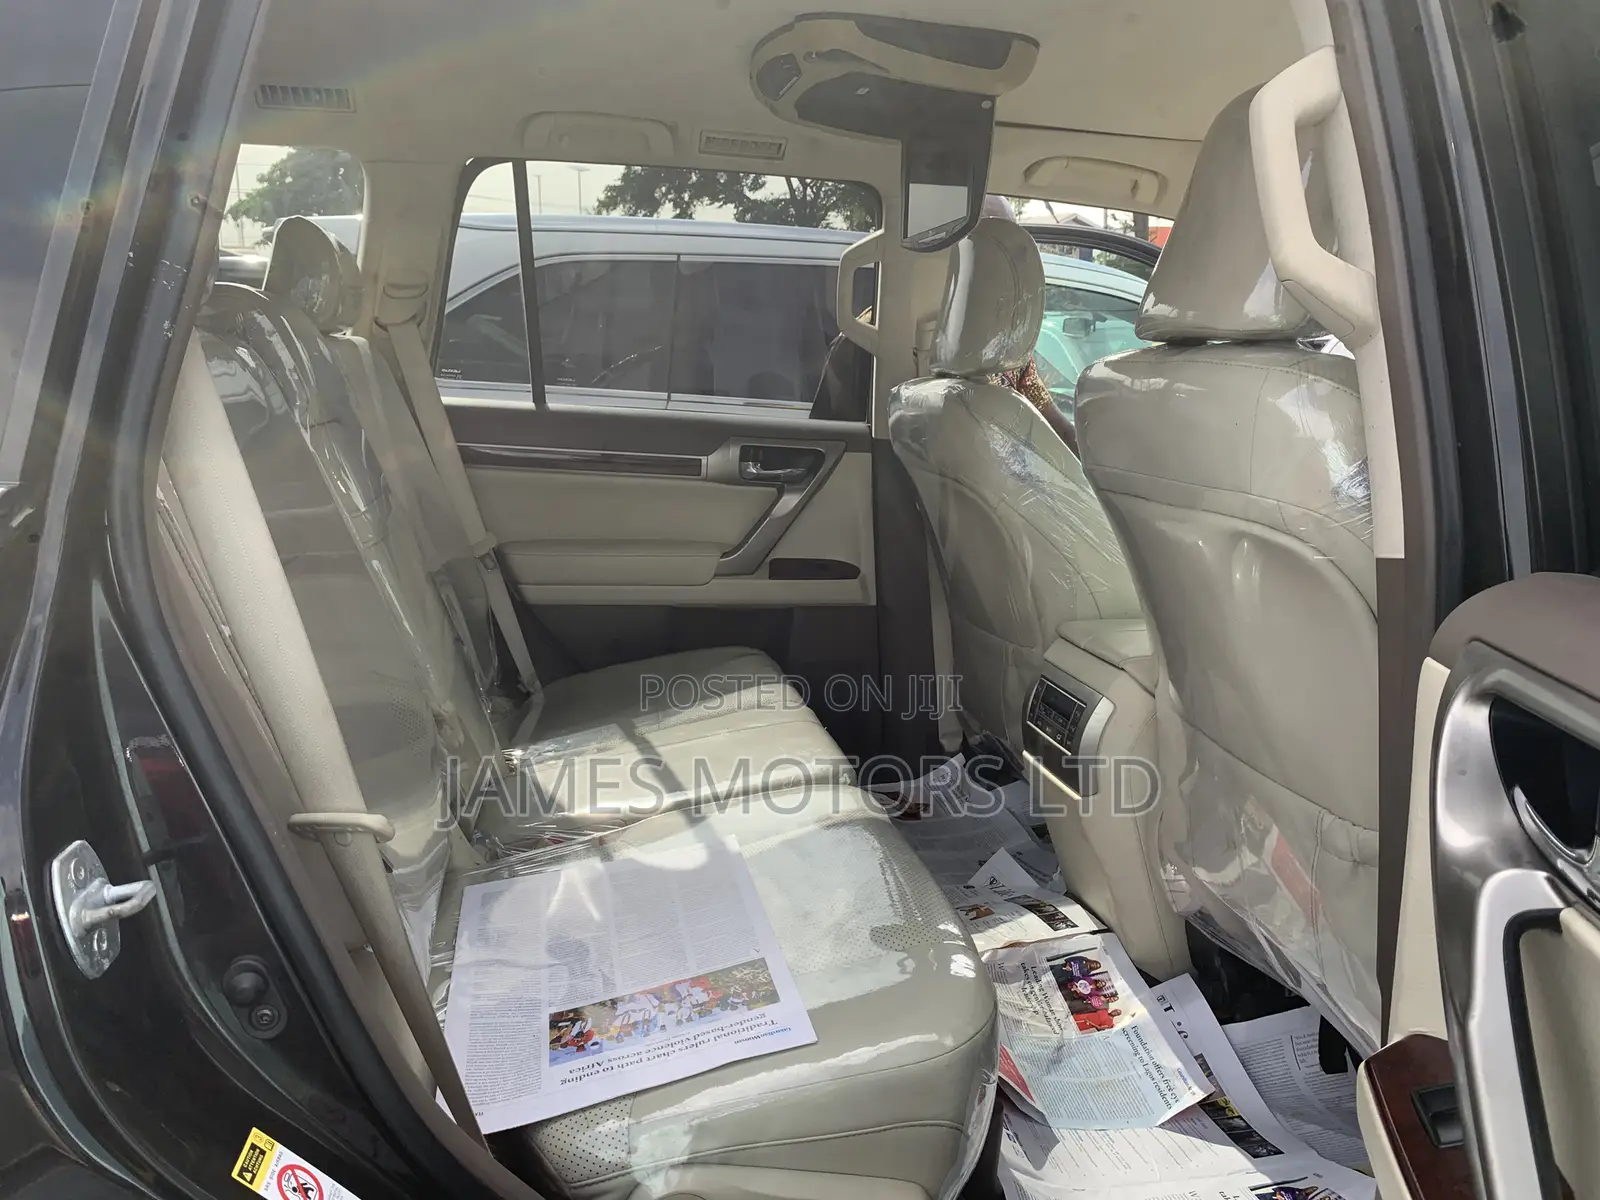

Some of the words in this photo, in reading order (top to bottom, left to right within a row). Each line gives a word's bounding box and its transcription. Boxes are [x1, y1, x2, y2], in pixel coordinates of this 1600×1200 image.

[692, 1012, 765, 1040] gender-based
[713, 1019, 777, 1041] Traditional
[644, 1035, 690, 1053] violence
[678, 1038, 710, 1052] rulers
[607, 1050, 642, 1063] across
[617, 1057, 642, 1070] path
[646, 1049, 675, 1062] chart
[1131, 1024, 1155, 1060] Foundation
[1151, 1060, 1165, 1078] offers
[1162, 1077, 1174, 1092] free
[1170, 1092, 1179, 1103] eye
[568, 1059, 604, 1074] Africa
[602, 1065, 613, 1073] to
[1121, 1027, 1141, 1056] screening
[1137, 1055, 1145, 1064] to
[1142, 1062, 1155, 1081] Lagos
[1152, 1081, 1172, 1109] residents
[560, 1069, 599, 1085] ending
[243, 1150, 253, 1168] CAUTION
[247, 1148, 260, 1170] ATTENTION
[252, 1153, 263, 1173] ACHTUNG
